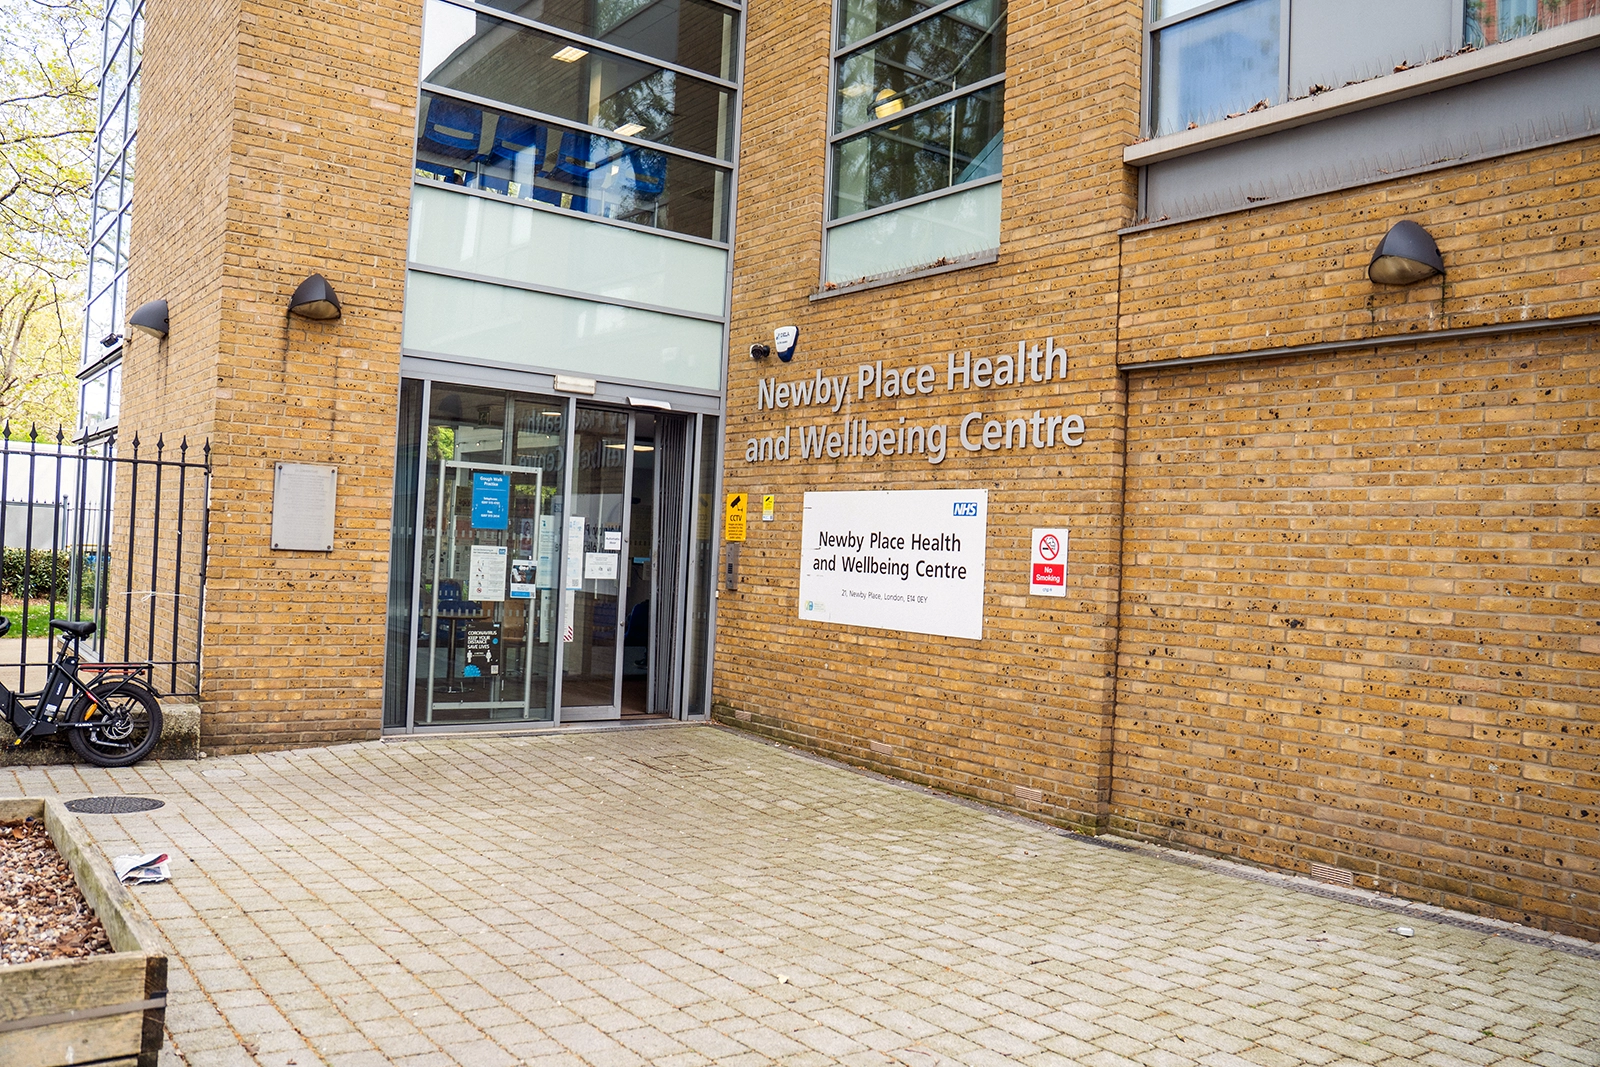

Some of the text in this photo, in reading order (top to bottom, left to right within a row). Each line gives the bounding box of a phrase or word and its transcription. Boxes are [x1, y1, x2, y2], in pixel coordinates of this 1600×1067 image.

[757, 337, 1068, 413] Newby Place Health
[745, 409, 1086, 464] and Wellbeing Centre
[954, 503, 977, 516] NHS
[819, 531, 961, 552] Newby Place Health
[813, 555, 967, 581] and Wellbeing Centre
[1036, 574, 1060, 583] Smoking
[849, 590, 867, 600] Newby
[868, 591, 883, 600] Place,
[884, 593, 905, 602] London,
